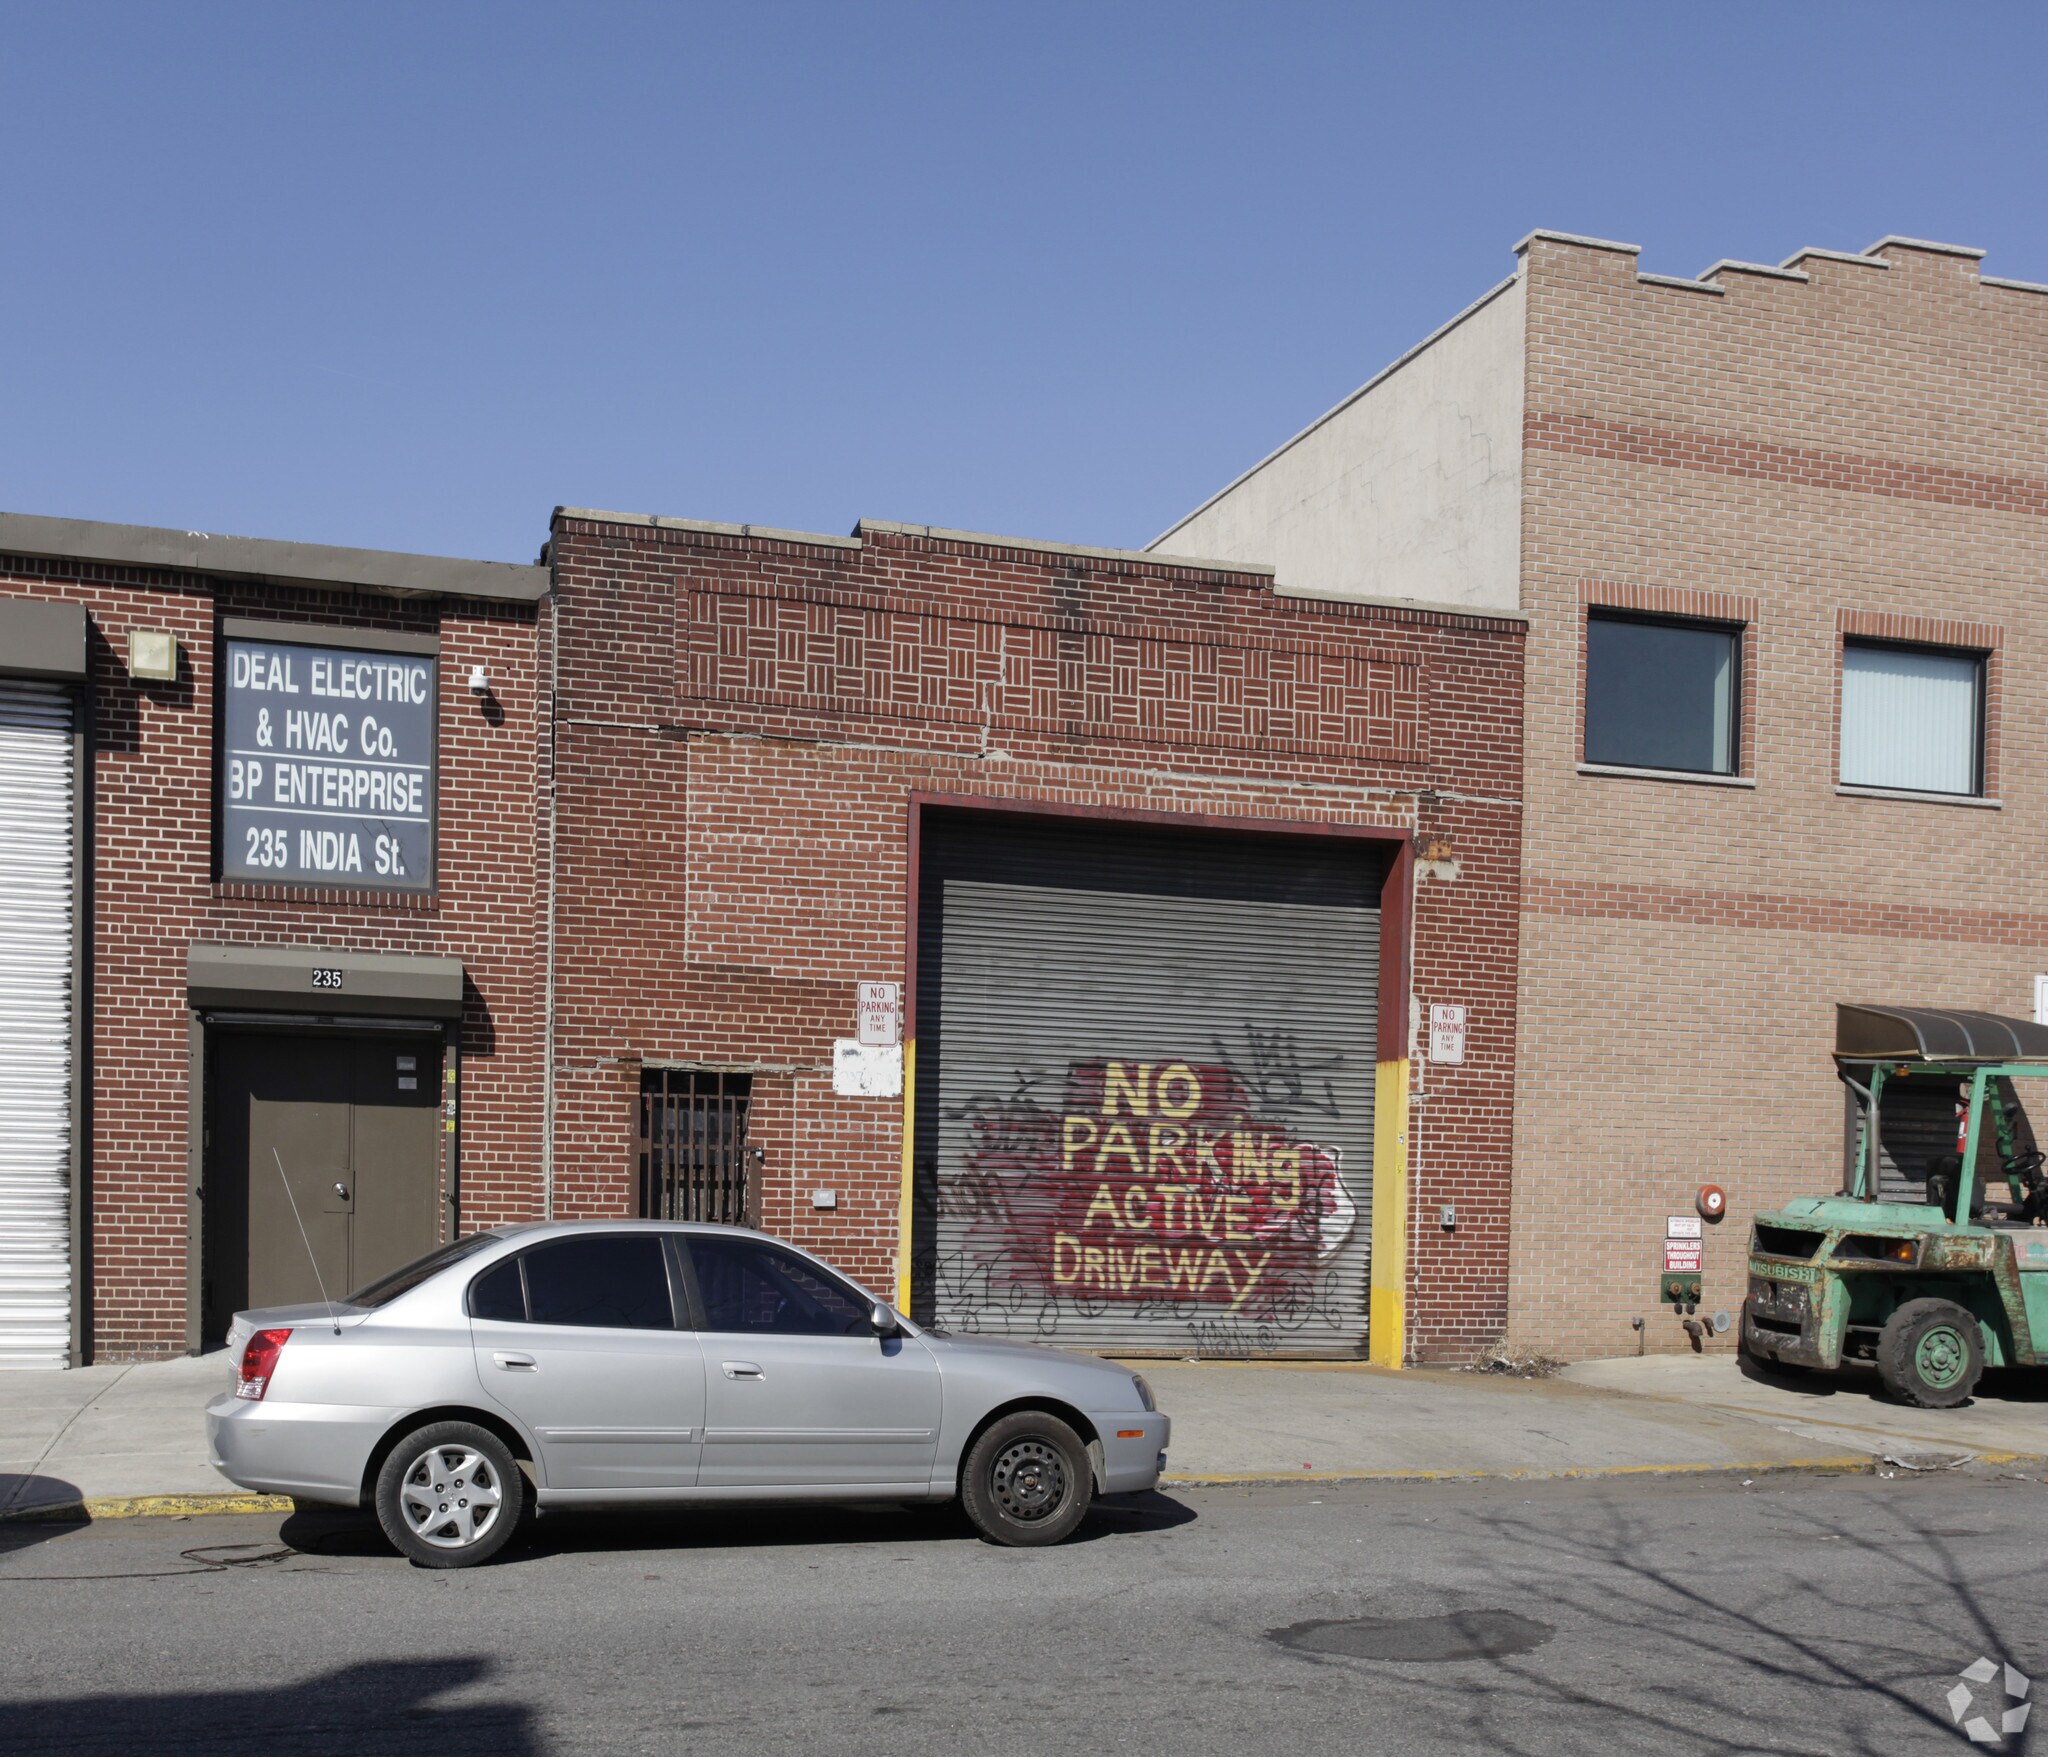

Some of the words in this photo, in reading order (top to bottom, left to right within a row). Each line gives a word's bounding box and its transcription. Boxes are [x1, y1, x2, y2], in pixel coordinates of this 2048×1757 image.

[311, 656, 426, 704] ELECTRIC
[256, 707, 273, 747] &
[286, 709, 348, 753] HVAC
[230, 759, 263, 799] BP
[275, 762, 423, 813] ENTERPRISE
[246, 827, 287, 868] 235
[300, 829, 362, 872] INDIA
[374, 834, 404, 875] St.
[313, 970, 341, 987] 235
[870, 987, 885, 999] NO
[861, 1001, 895, 1014] PARKING
[870, 1014, 885, 1023] ANY
[1442, 1009, 1455, 1020] NO
[869, 1023, 886, 1032] TIME
[1434, 1022, 1462, 1033] PARKING
[1440, 1043, 1454, 1051] TIME
[1101, 1062, 1202, 1119] NO
[1083, 1183, 1253, 1241] ACTIVE
[1666, 1242, 1700, 1250] SPRINKLERS
[1667, 1251, 1699, 1259] THROUGHOUT
[1669, 1260, 1697, 1269] BUILDING
